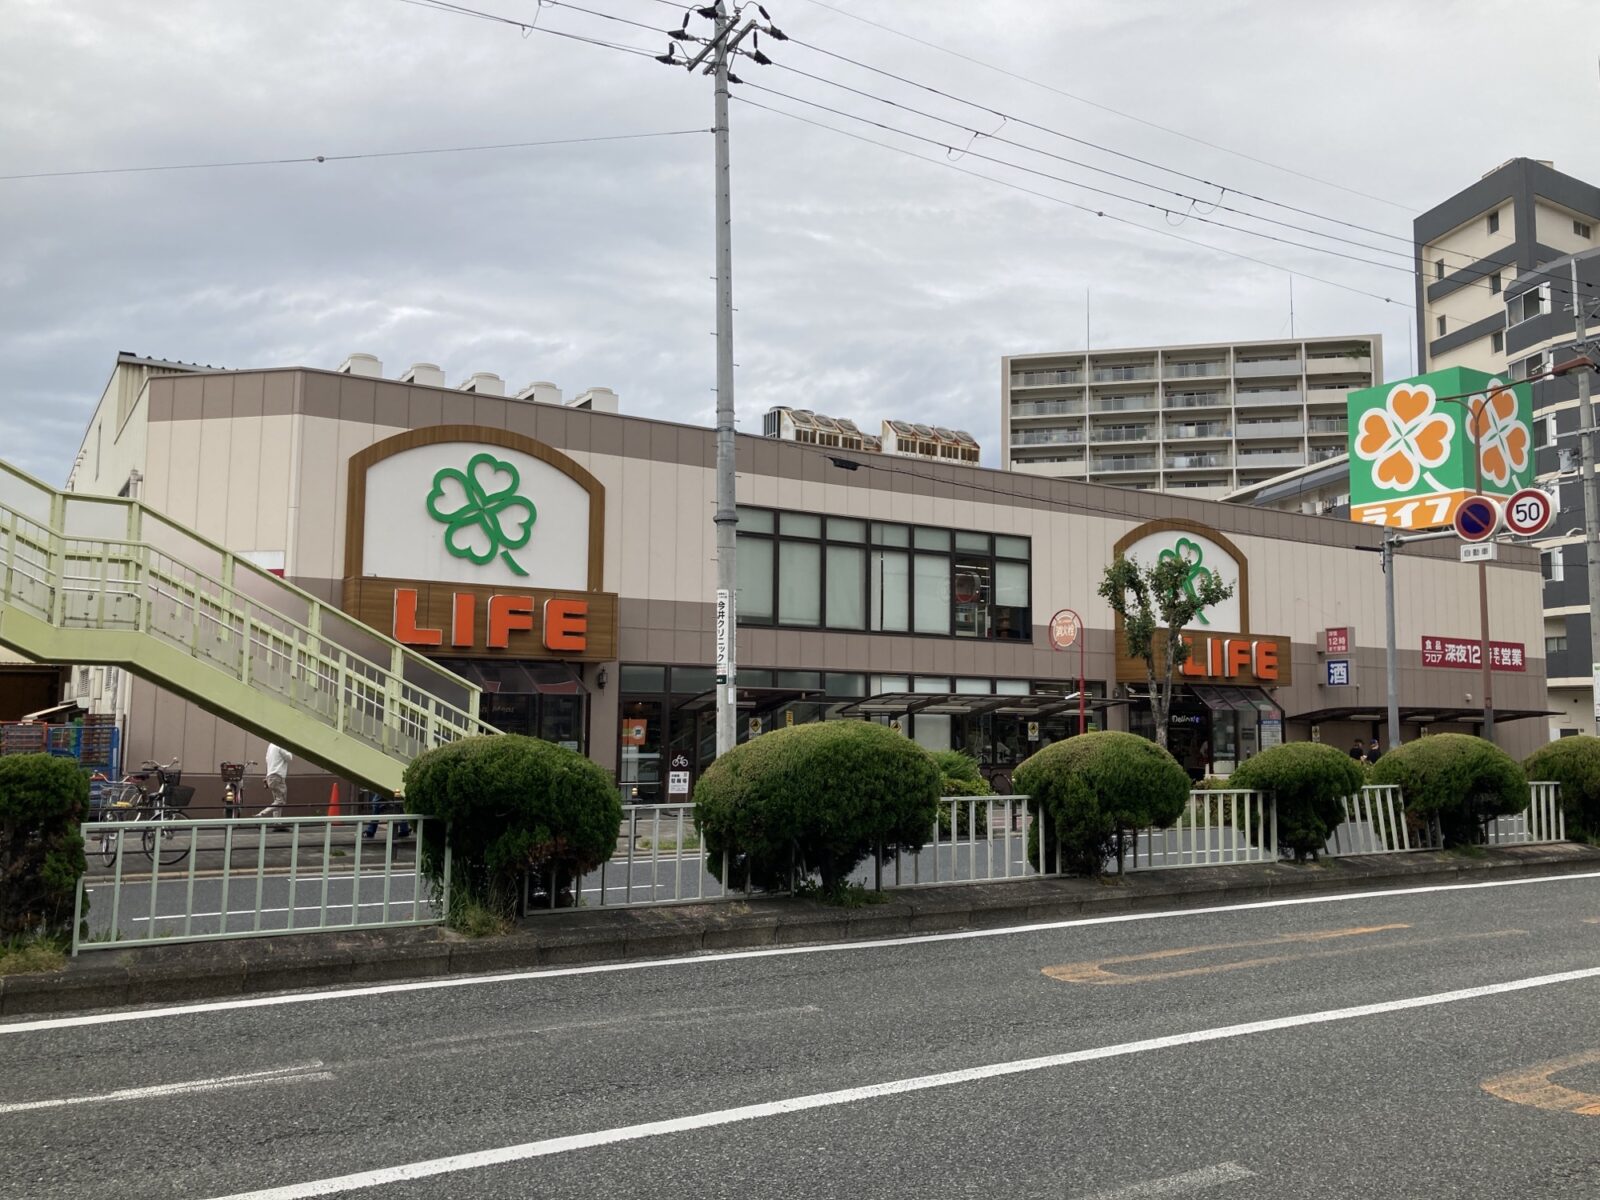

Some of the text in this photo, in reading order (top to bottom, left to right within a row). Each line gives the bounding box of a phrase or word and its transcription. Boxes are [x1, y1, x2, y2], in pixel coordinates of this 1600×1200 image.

[1362, 496, 1452, 527] ライフ
[1515, 502, 1540, 523] 50
[1463, 547, 1489, 557] 自動車
[393, 588, 588, 651] LIFE
[718, 600, 726, 662] 今井クリニック
[1328, 637, 1346, 645] 12時
[1425, 639, 1442, 650] 食品
[1178, 634, 1279, 680] LIFE
[1425, 653, 1442, 663] フロア
[1329, 662, 1348, 684] 酒
